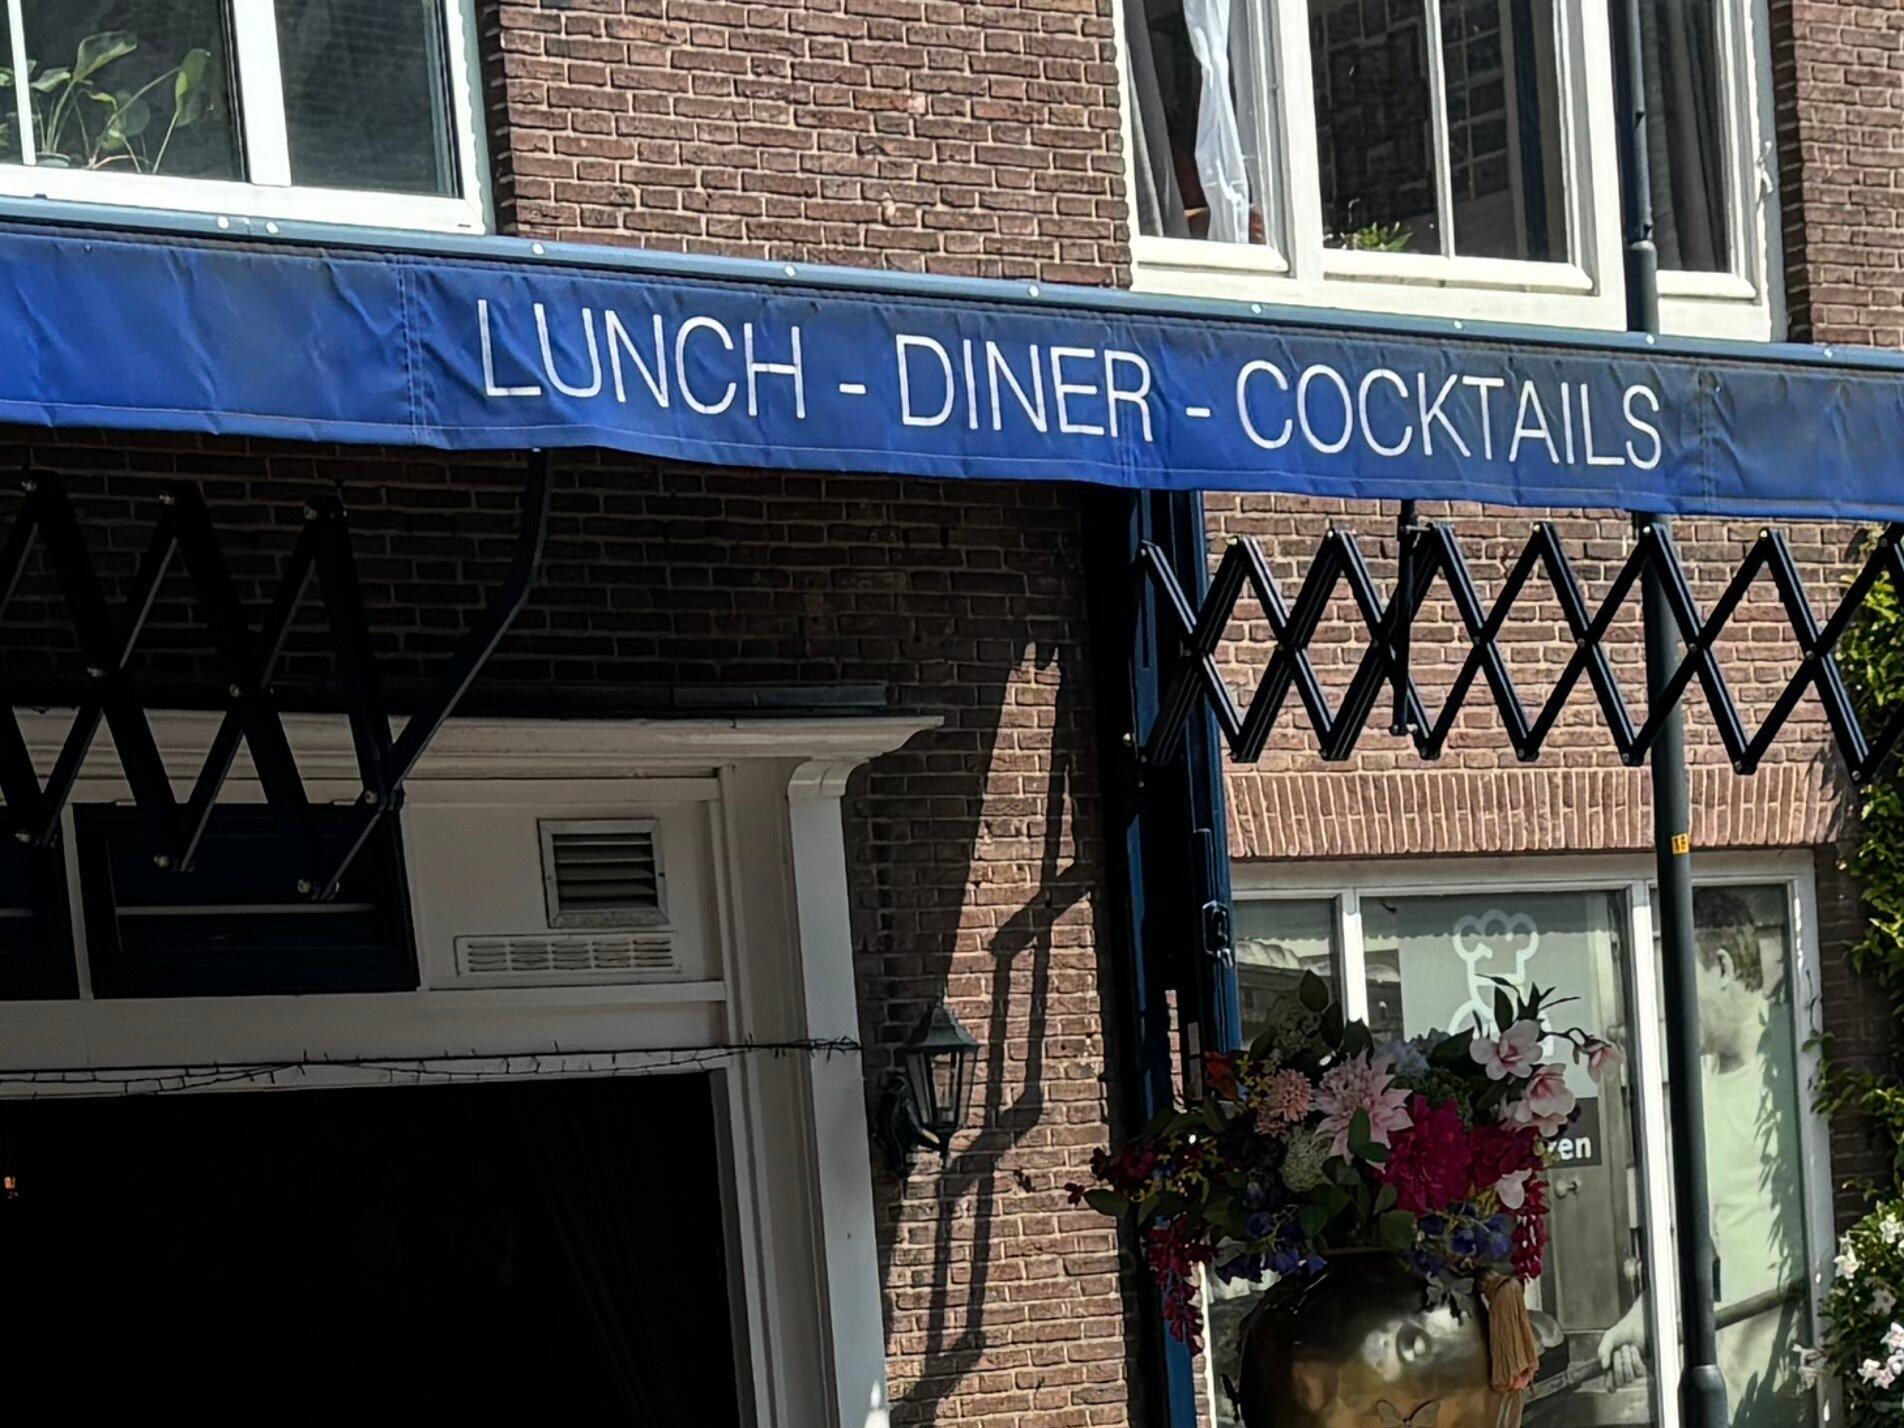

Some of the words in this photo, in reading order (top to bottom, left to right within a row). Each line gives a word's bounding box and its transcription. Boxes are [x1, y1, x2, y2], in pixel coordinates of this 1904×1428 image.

[477, 299, 806, 418] LUNCH
[896, 334, 1153, 442] DINER
[1236, 360, 1662, 470] COCKTAILS
